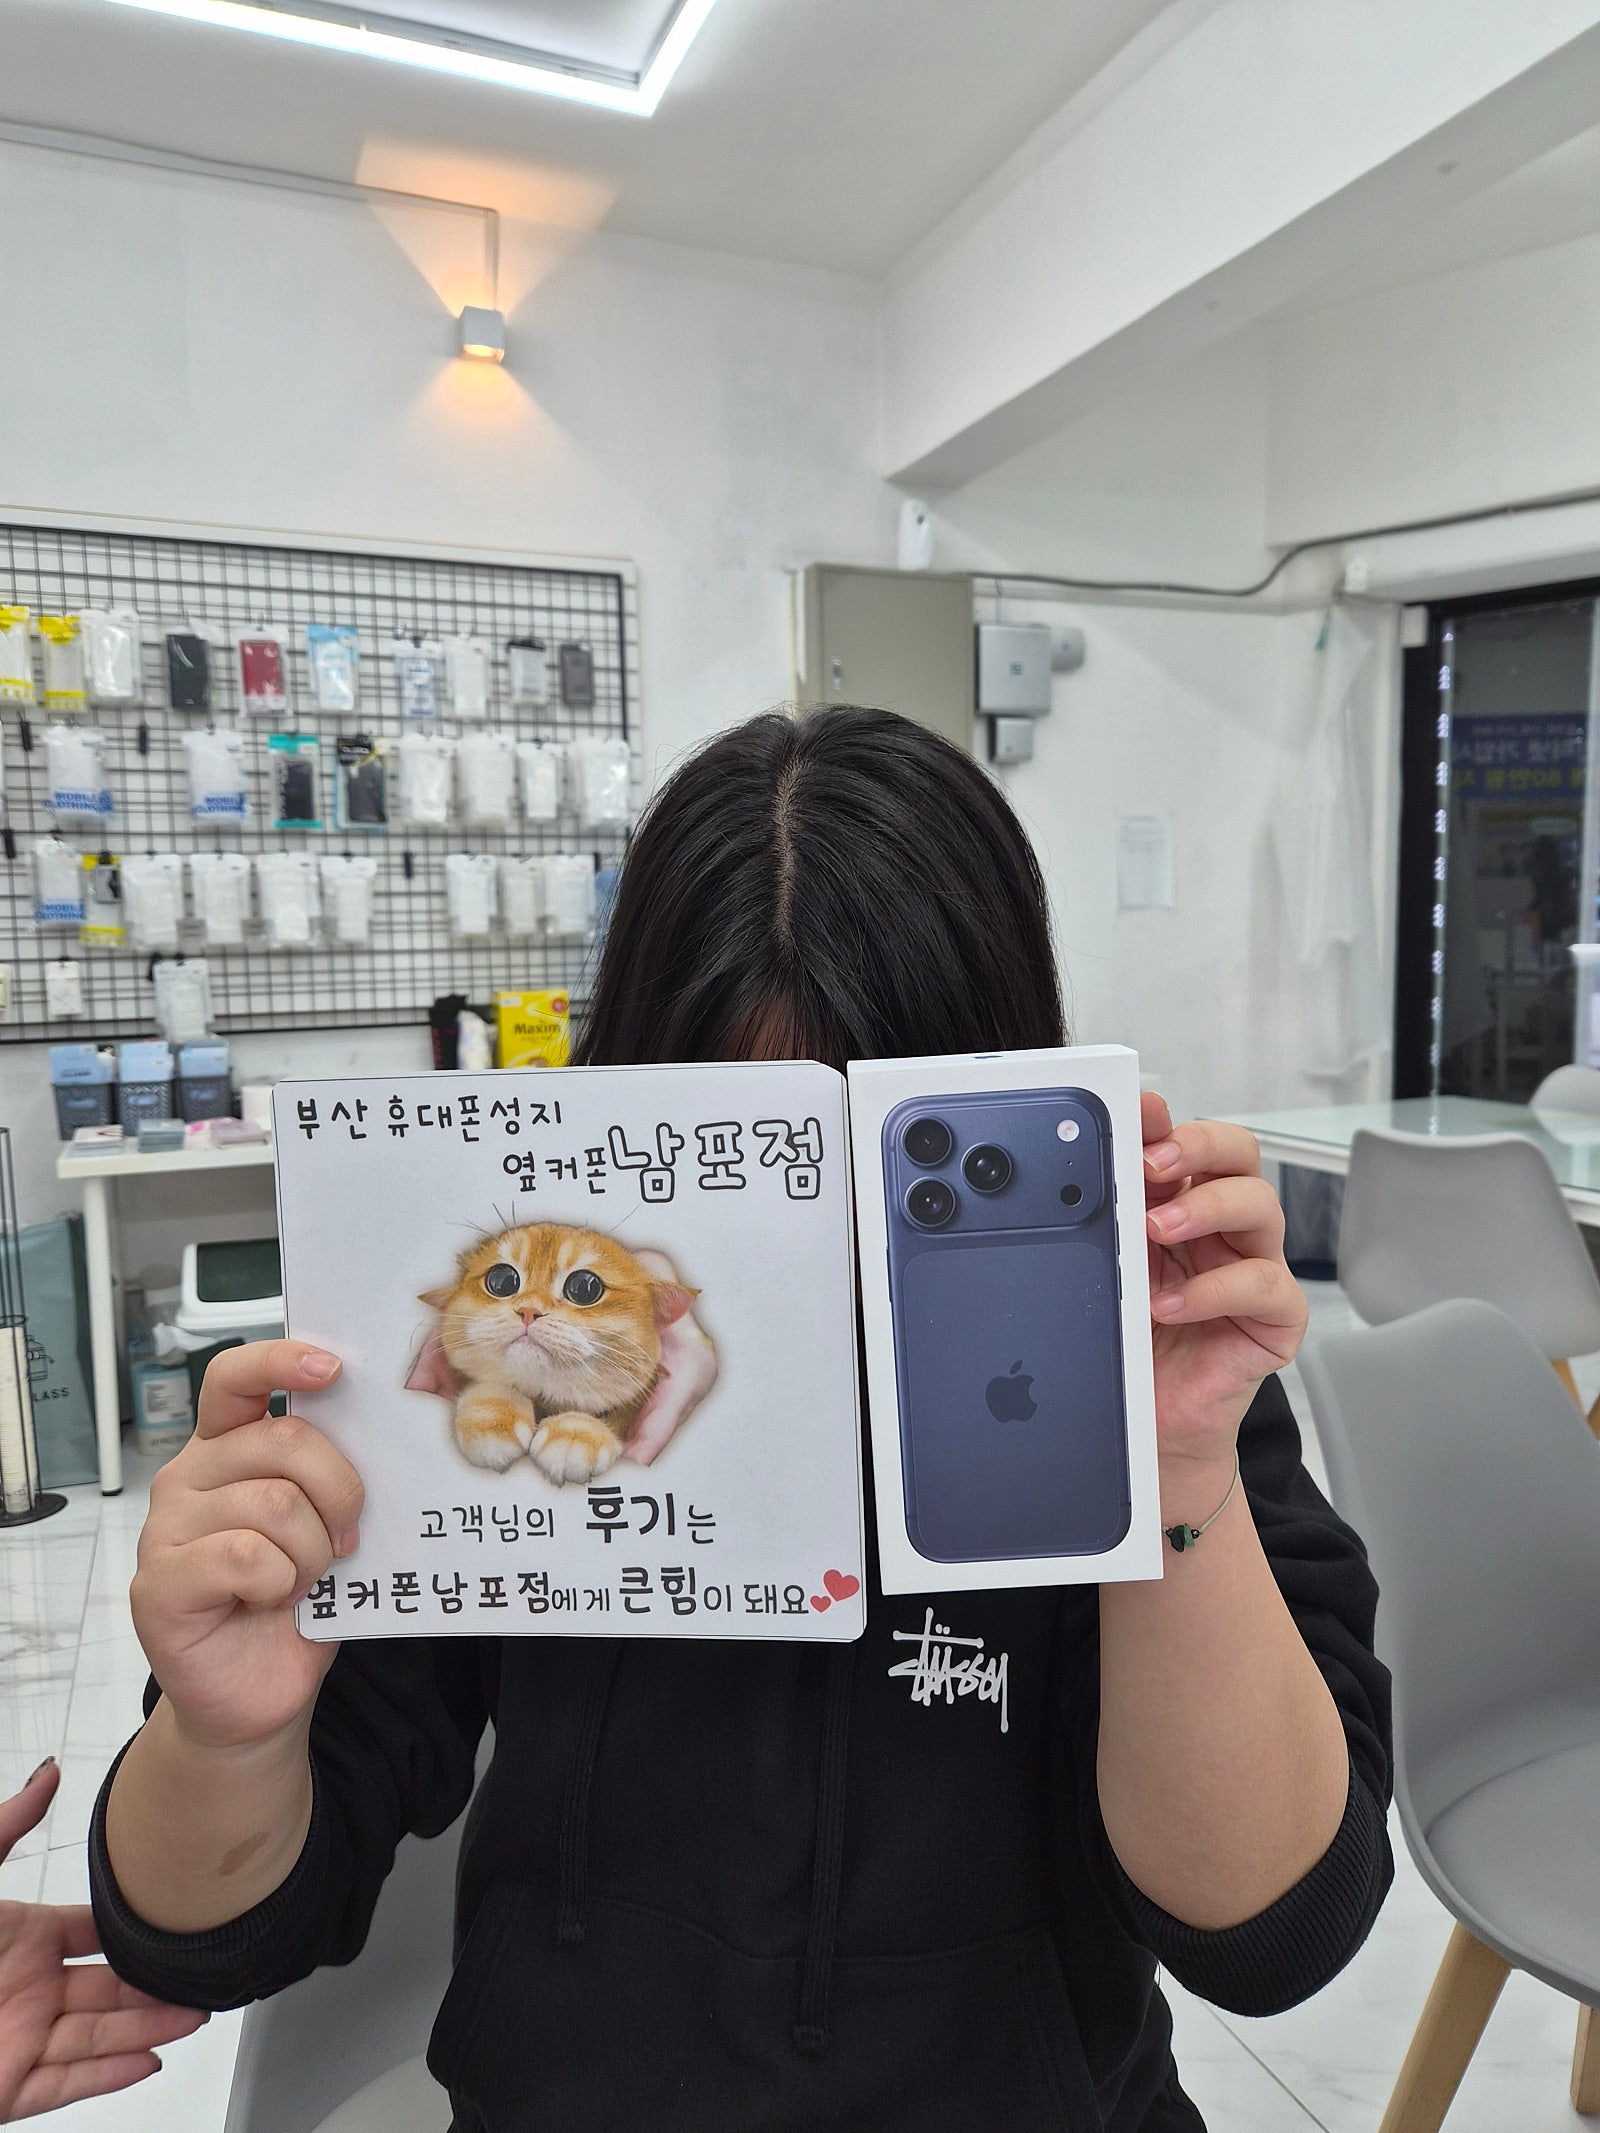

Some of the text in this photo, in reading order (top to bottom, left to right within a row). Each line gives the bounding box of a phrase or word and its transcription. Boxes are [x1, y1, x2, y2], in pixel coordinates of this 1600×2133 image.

[513, 1020, 561, 1036] Maxim
[297, 1098, 369, 1140] 부산
[33, 1386, 70, 1402] LASS
[420, 1504, 554, 1543] 고객님의
[743, 1583, 809, 1615] 돼요
